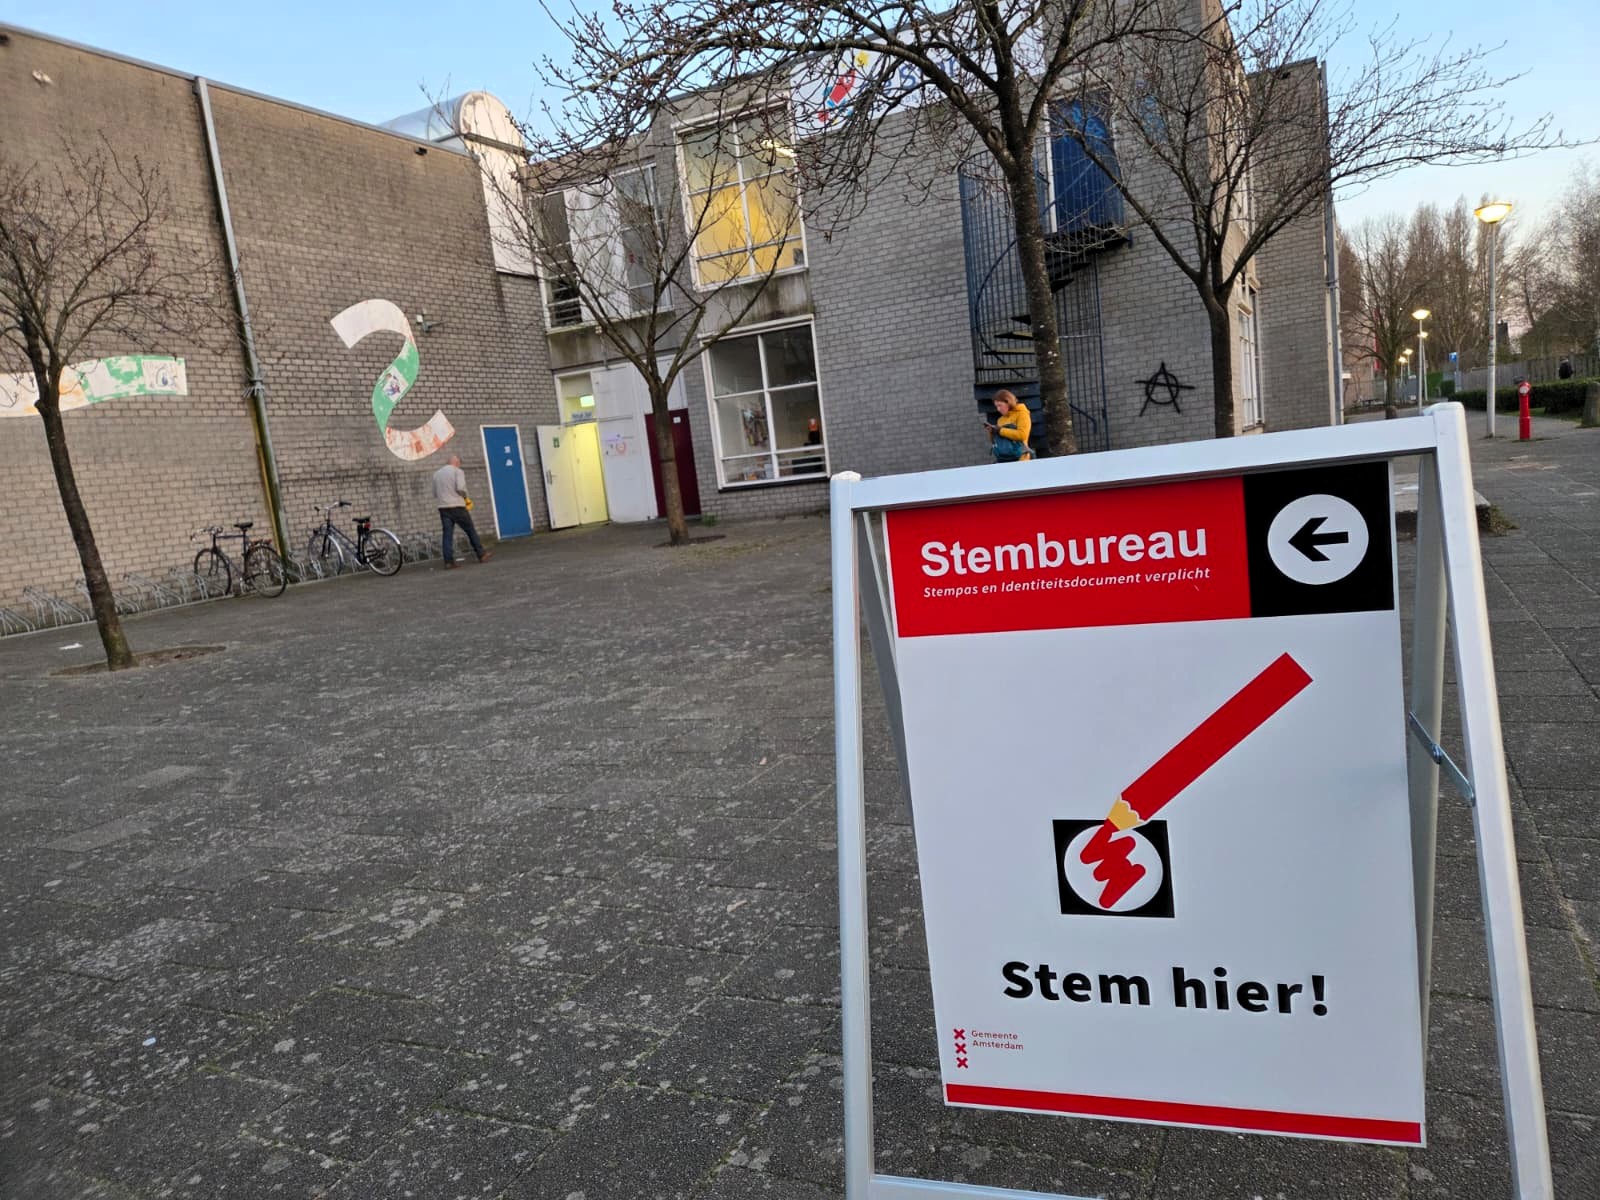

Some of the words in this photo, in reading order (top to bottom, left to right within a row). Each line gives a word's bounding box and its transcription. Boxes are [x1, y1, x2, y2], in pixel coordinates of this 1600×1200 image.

[921, 528, 1207, 577] Stembureau
[923, 585, 979, 598] Stempas
[981, 584, 997, 594] en
[1000, 573, 1141, 593] Identiteitsdocument
[1144, 567, 1210, 584] verplicht
[1002, 961, 1151, 1006] Stem
[1172, 966, 1328, 1017] hier!
[971, 1029, 1018, 1040] Gemeente
[972, 1039, 1024, 1051] Amsterdam
